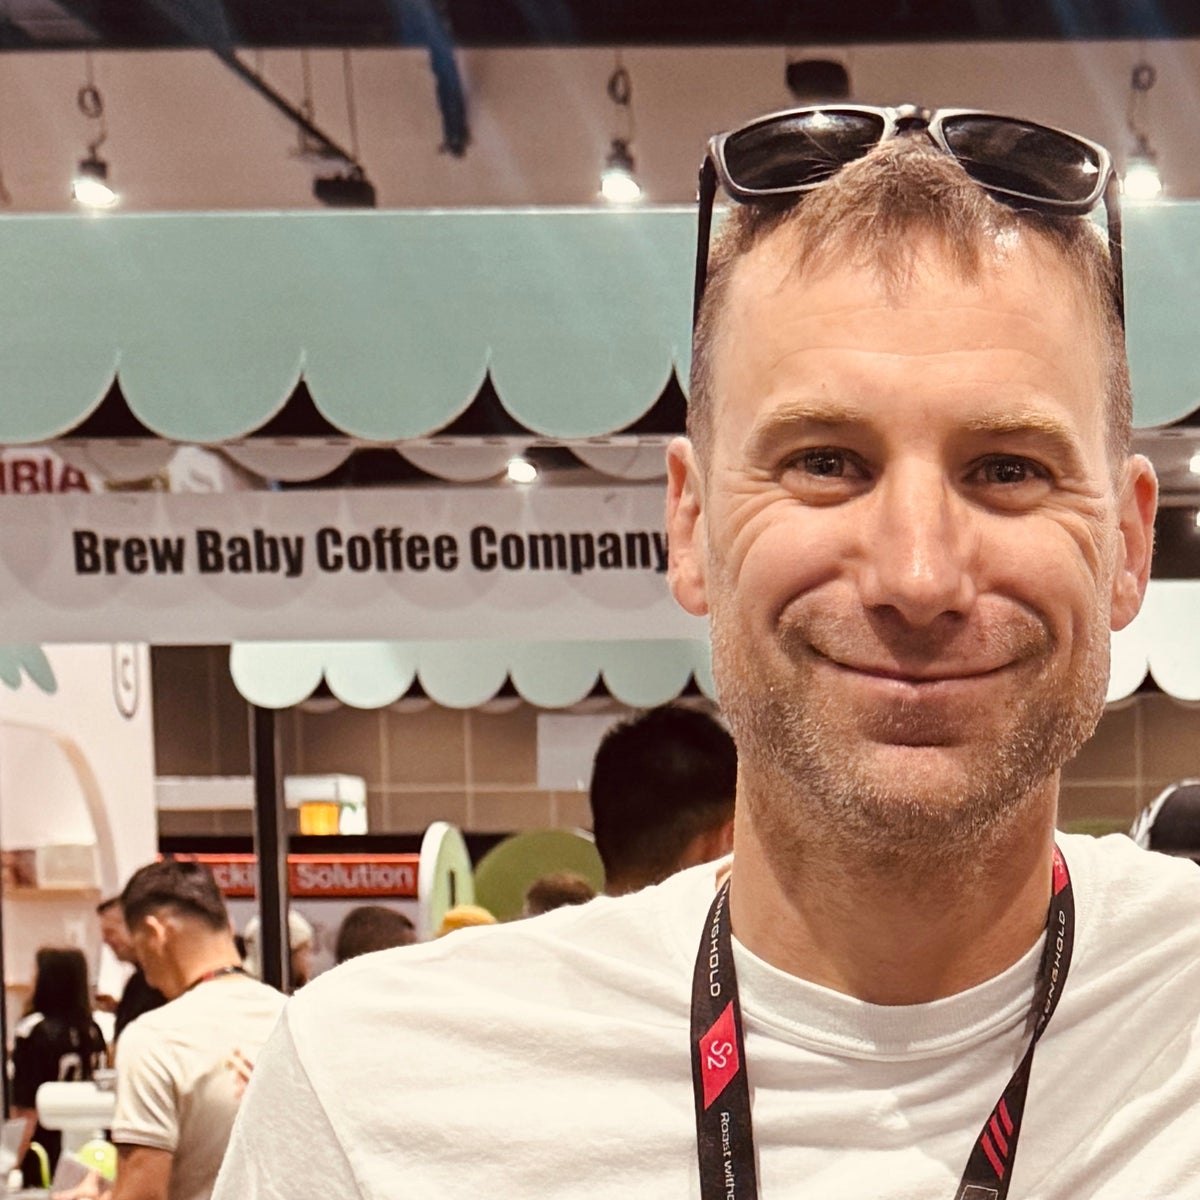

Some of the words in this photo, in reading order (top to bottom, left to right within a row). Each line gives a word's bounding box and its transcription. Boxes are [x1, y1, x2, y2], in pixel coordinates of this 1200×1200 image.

[0, 457, 91, 493] RIA
[73, 529, 186, 575] Brew
[196, 528, 304, 578] Baby
[316, 526, 460, 573] Coffee
[470, 525, 669, 575] Company
[296, 863, 415, 889] Solution
[707, 1039, 733, 1070] S2
